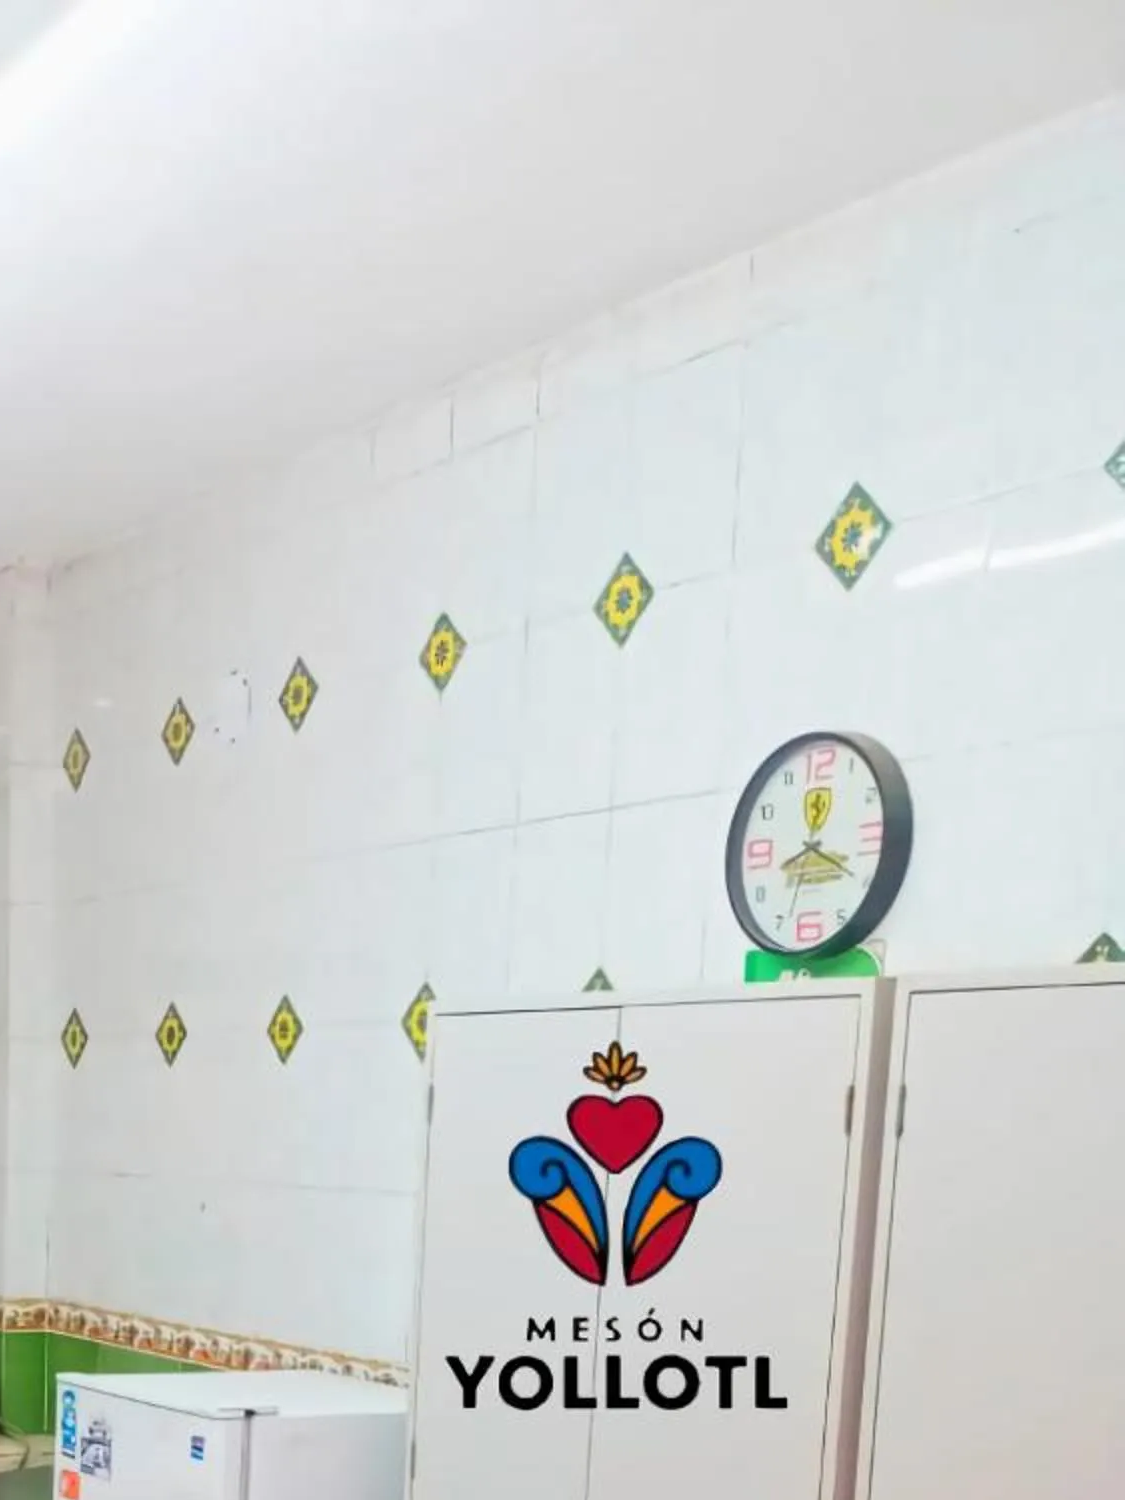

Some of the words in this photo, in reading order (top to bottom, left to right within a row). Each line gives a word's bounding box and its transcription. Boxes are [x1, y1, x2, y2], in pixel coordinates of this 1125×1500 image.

[806, 748, 837, 783] 12
[747, 838, 773, 870] 9
[857, 820, 882, 857] 3
[775, 913, 785, 932] 7
[796, 910, 823, 942] 6
